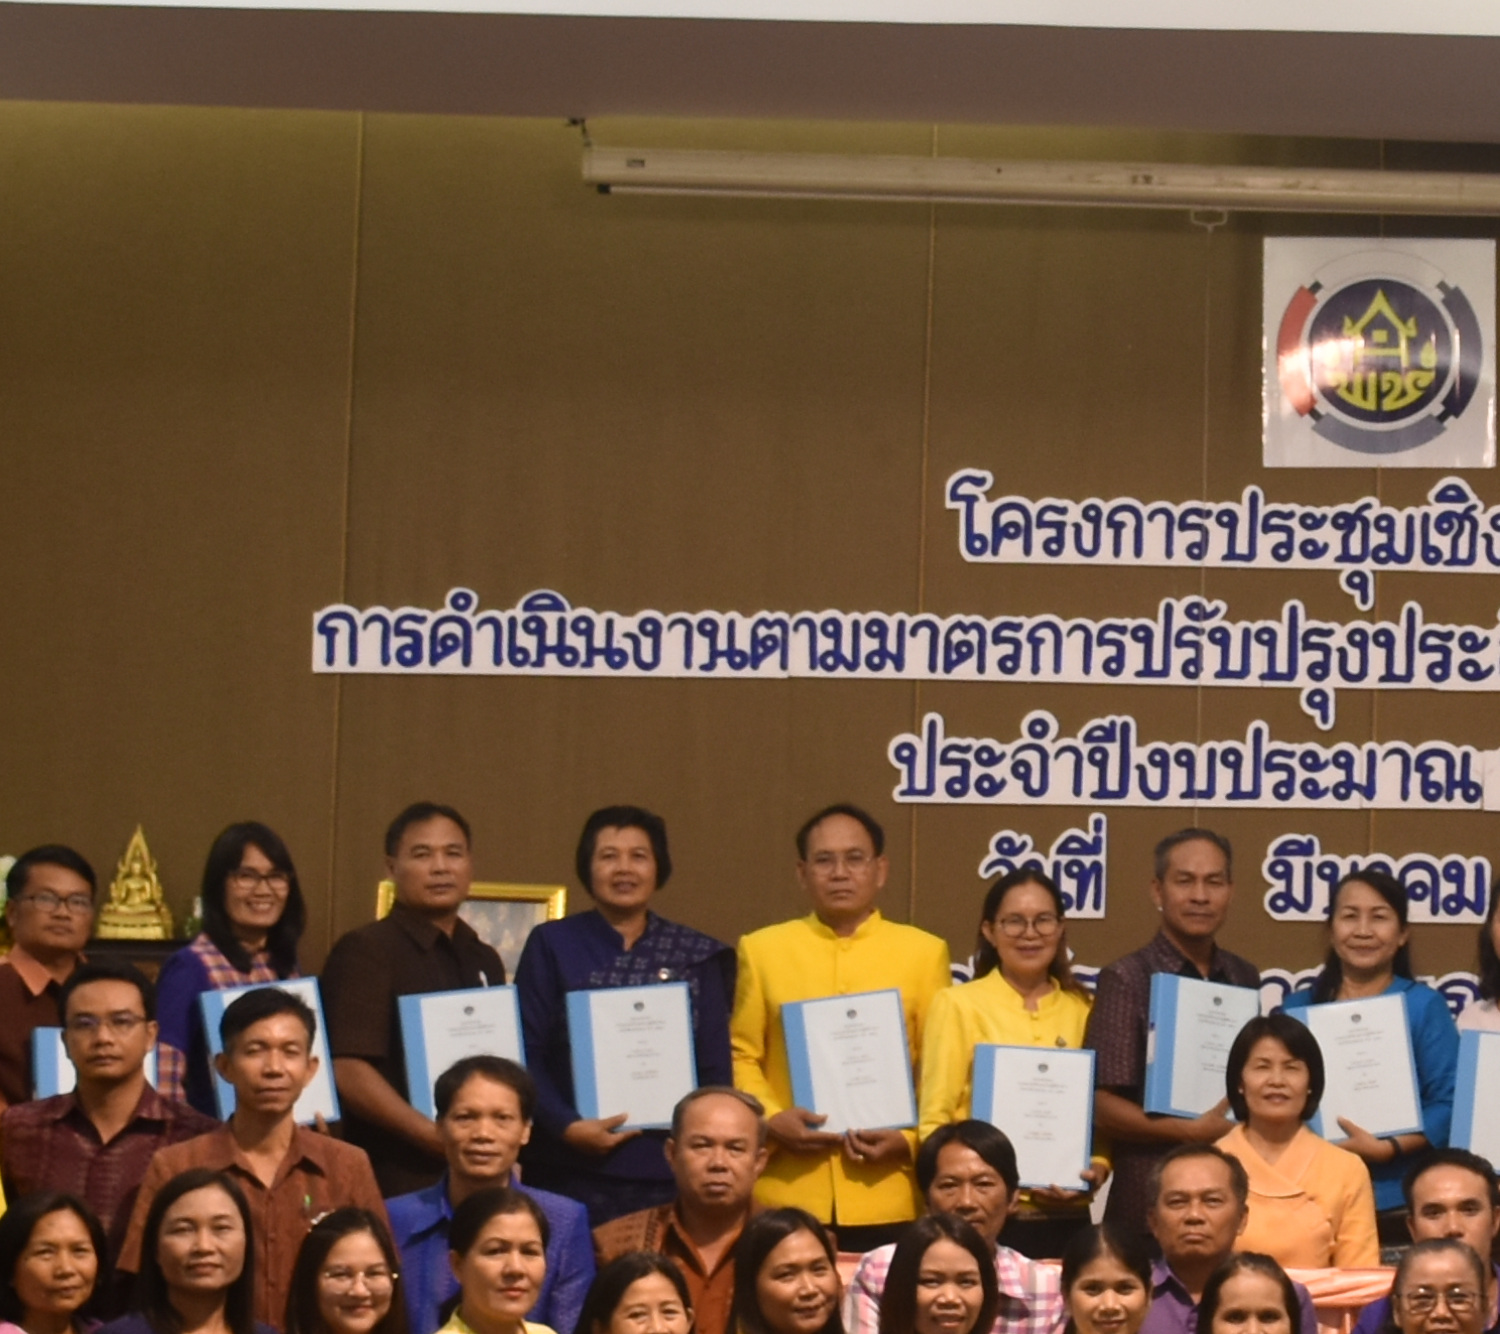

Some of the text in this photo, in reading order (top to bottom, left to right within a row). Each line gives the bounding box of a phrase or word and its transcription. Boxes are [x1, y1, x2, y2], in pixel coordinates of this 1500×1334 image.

[894, 717, 1483, 802] ประจำปีงบประมาณ
[1268, 837, 1486, 916] มีคม
